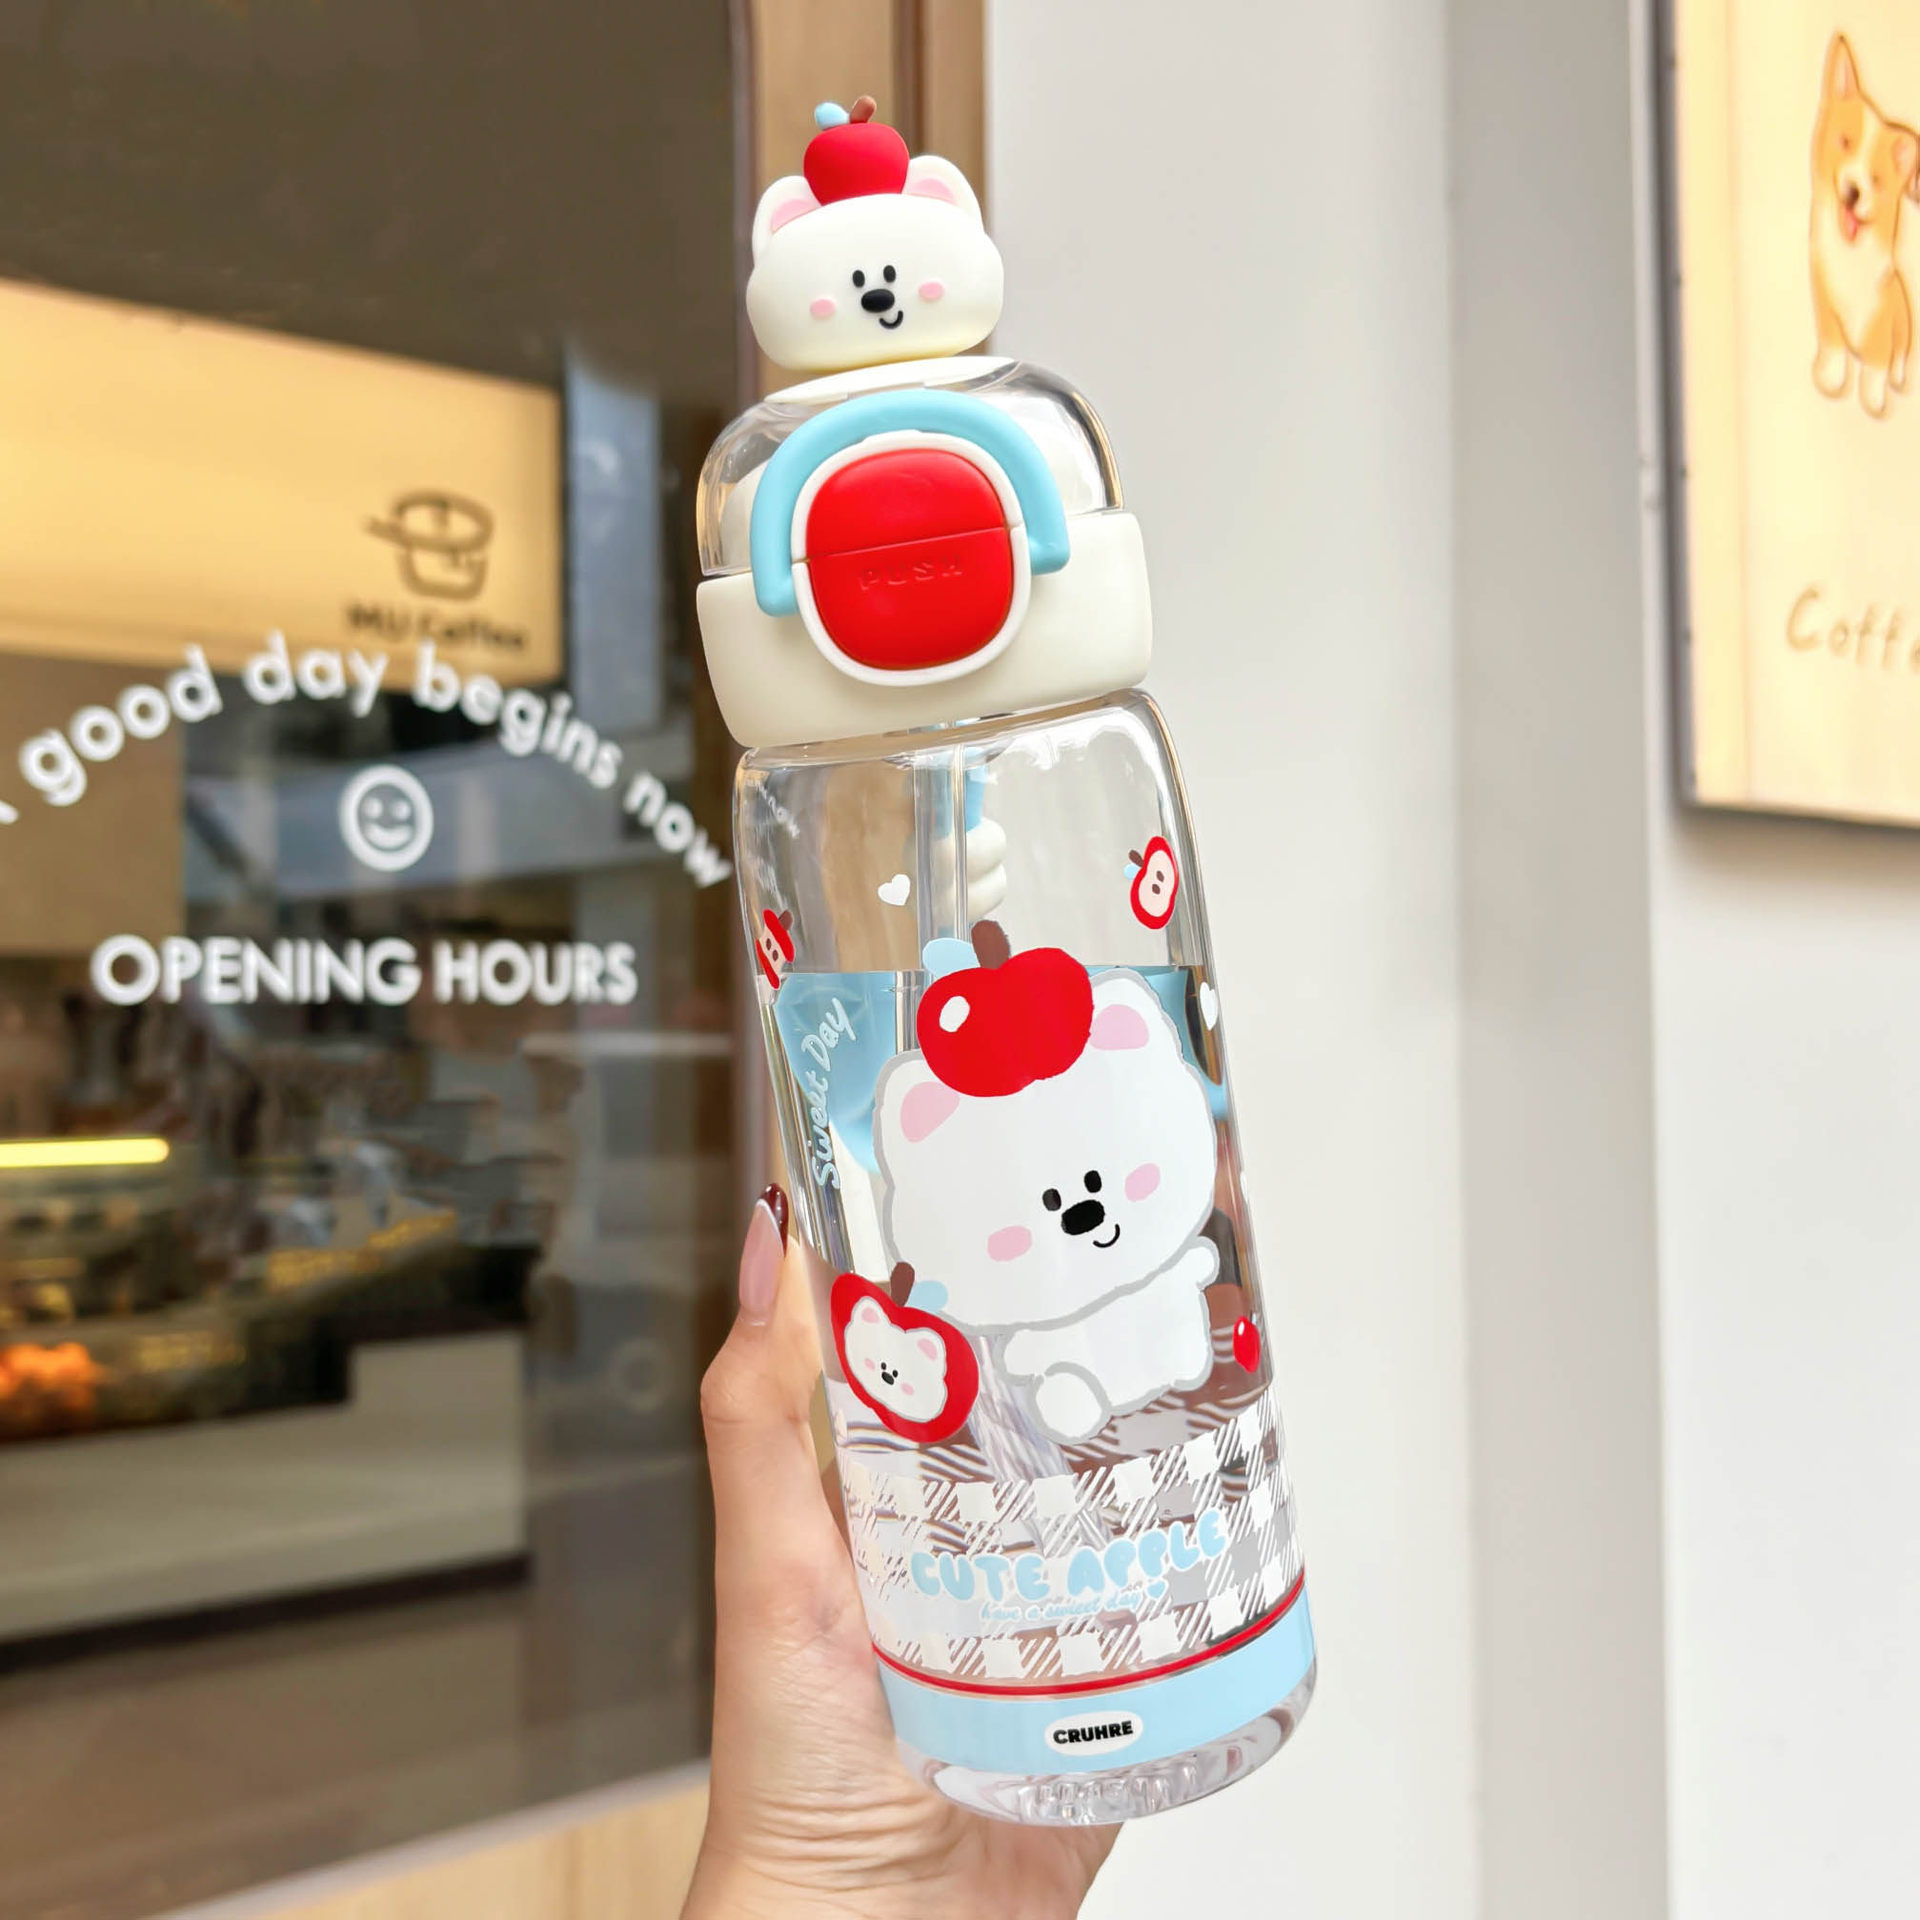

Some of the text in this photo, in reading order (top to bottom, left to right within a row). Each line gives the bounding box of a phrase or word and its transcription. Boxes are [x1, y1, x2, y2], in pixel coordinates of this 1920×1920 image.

[860, 552, 965, 591] PUSH
[18, 642, 223, 807] good
[243, 631, 389, 717] day
[414, 640, 625, 790] begins
[625, 771, 732, 889] now
[91, 935, 638, 1006] OPENING HOURS
[800, 997, 857, 1190] Sweet Day
[911, 1508, 1228, 1601] CUTE APPLE
[1052, 1719, 1134, 1745] CRUHRE
